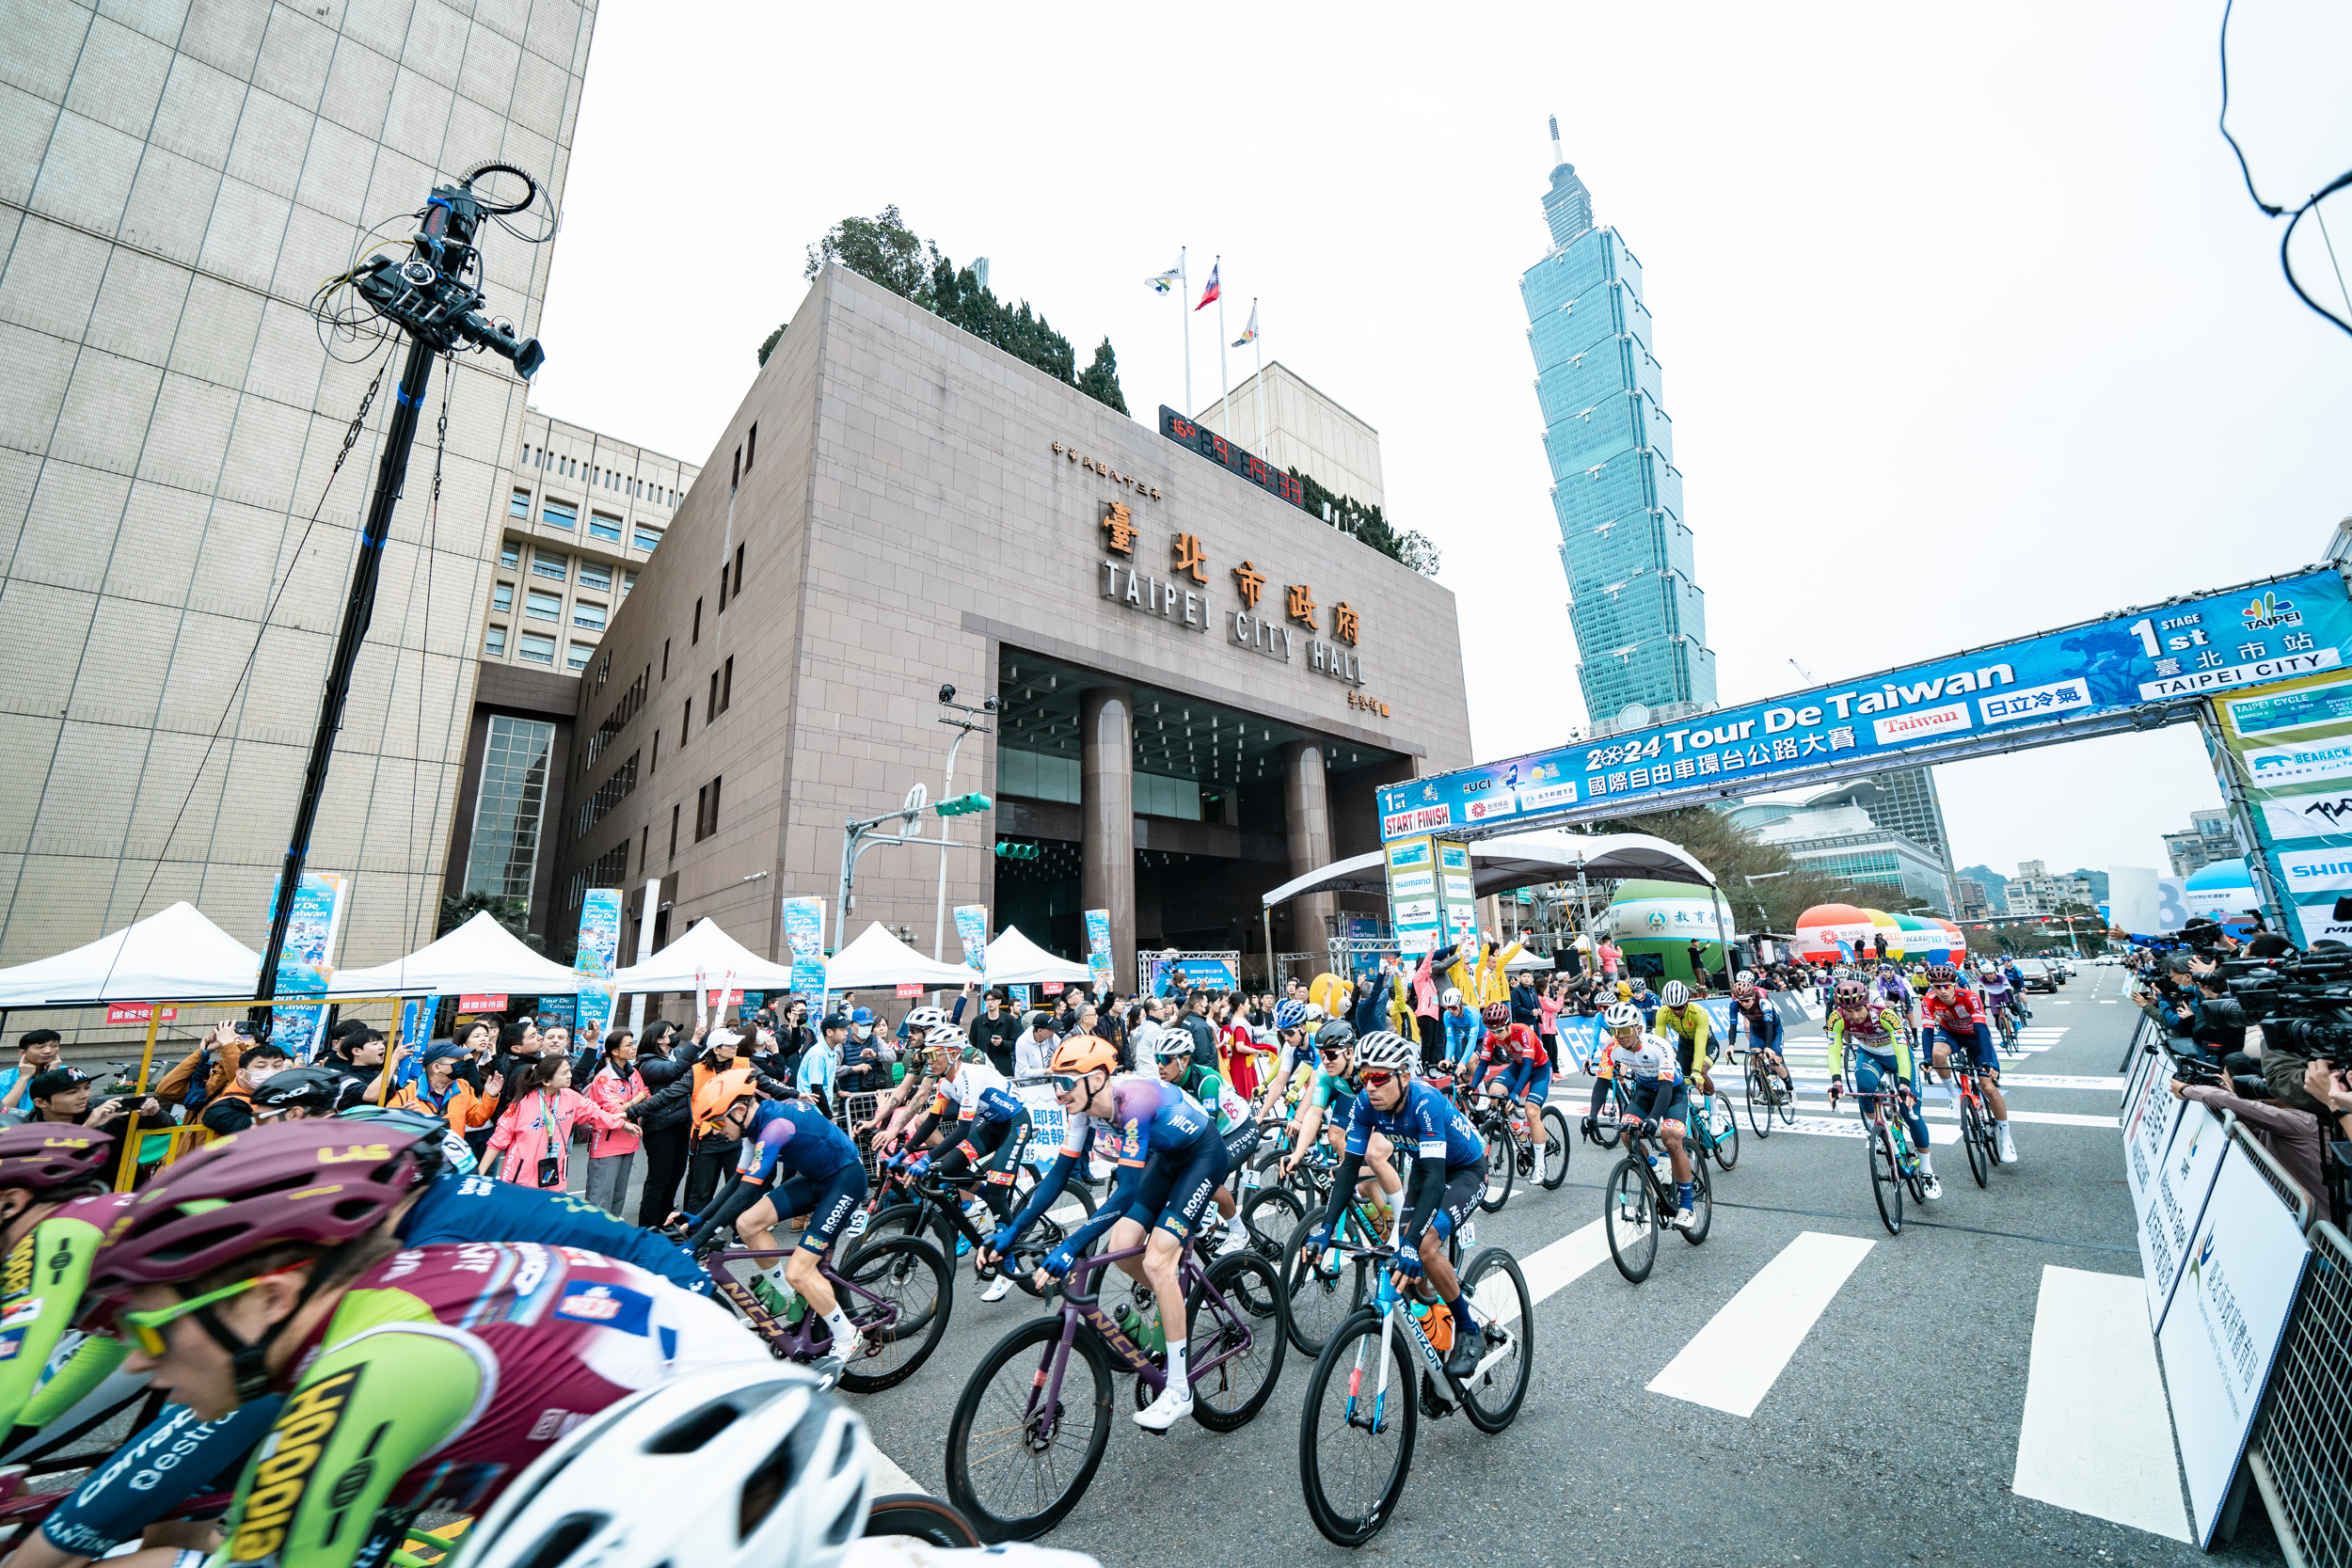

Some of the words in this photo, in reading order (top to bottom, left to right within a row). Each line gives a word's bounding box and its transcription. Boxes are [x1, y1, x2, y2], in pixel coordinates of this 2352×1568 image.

[1053, 440, 1162, 501] 中華民國八十三年
[1103, 501, 1360, 645] 臺北市政府
[1103, 560, 1210, 629] TAIPEI
[1234, 610, 1292, 658] CITY
[1312, 639, 1366, 685] HALL
[2161, 613, 2201, 630] STAGE
[2245, 611, 2301, 630] TAIPEI
[2153, 631, 2314, 677] 臺北市站
[2155, 669, 2242, 694] TAIPEI
[2256, 654, 2320, 676] CITY
[1987, 686, 2082, 719] 日立冷氣
[2235, 701, 2269, 713] TAIPEI
[2274, 694, 2309, 706] CYCLE
[1585, 736, 1662, 771] 2024
[1665, 719, 1756, 752] Tour
[1764, 705, 1822, 734] De
[1825, 663, 2014, 720] Taiwan
[1883, 711, 1959, 733] Taiwan
[1587, 726, 1855, 796] 國際自由車環台公路大賽
[1470, 779, 1491, 793] UCI
[1395, 878, 1431, 889] SHIMANO
[462, 1000, 504, 1009] 媒體接待區
[1034, 1109, 1062, 1127] 即刻
[1167, 1114, 1200, 1135] NICH
[1028, 1129, 1065, 1146] 始報
[1226, 1127, 1257, 1152] VICTORIA
[1248, 1172, 1253, 1183] 2
[848, 1214, 865, 1234] 165
[1355, 1207, 1383, 1245] BENOTT
[723, 1282, 785, 1338] NICH
[2206, 1259, 2259, 1394] 臺北市政府體育局
[1088, 1310, 1148, 1369] NICH
